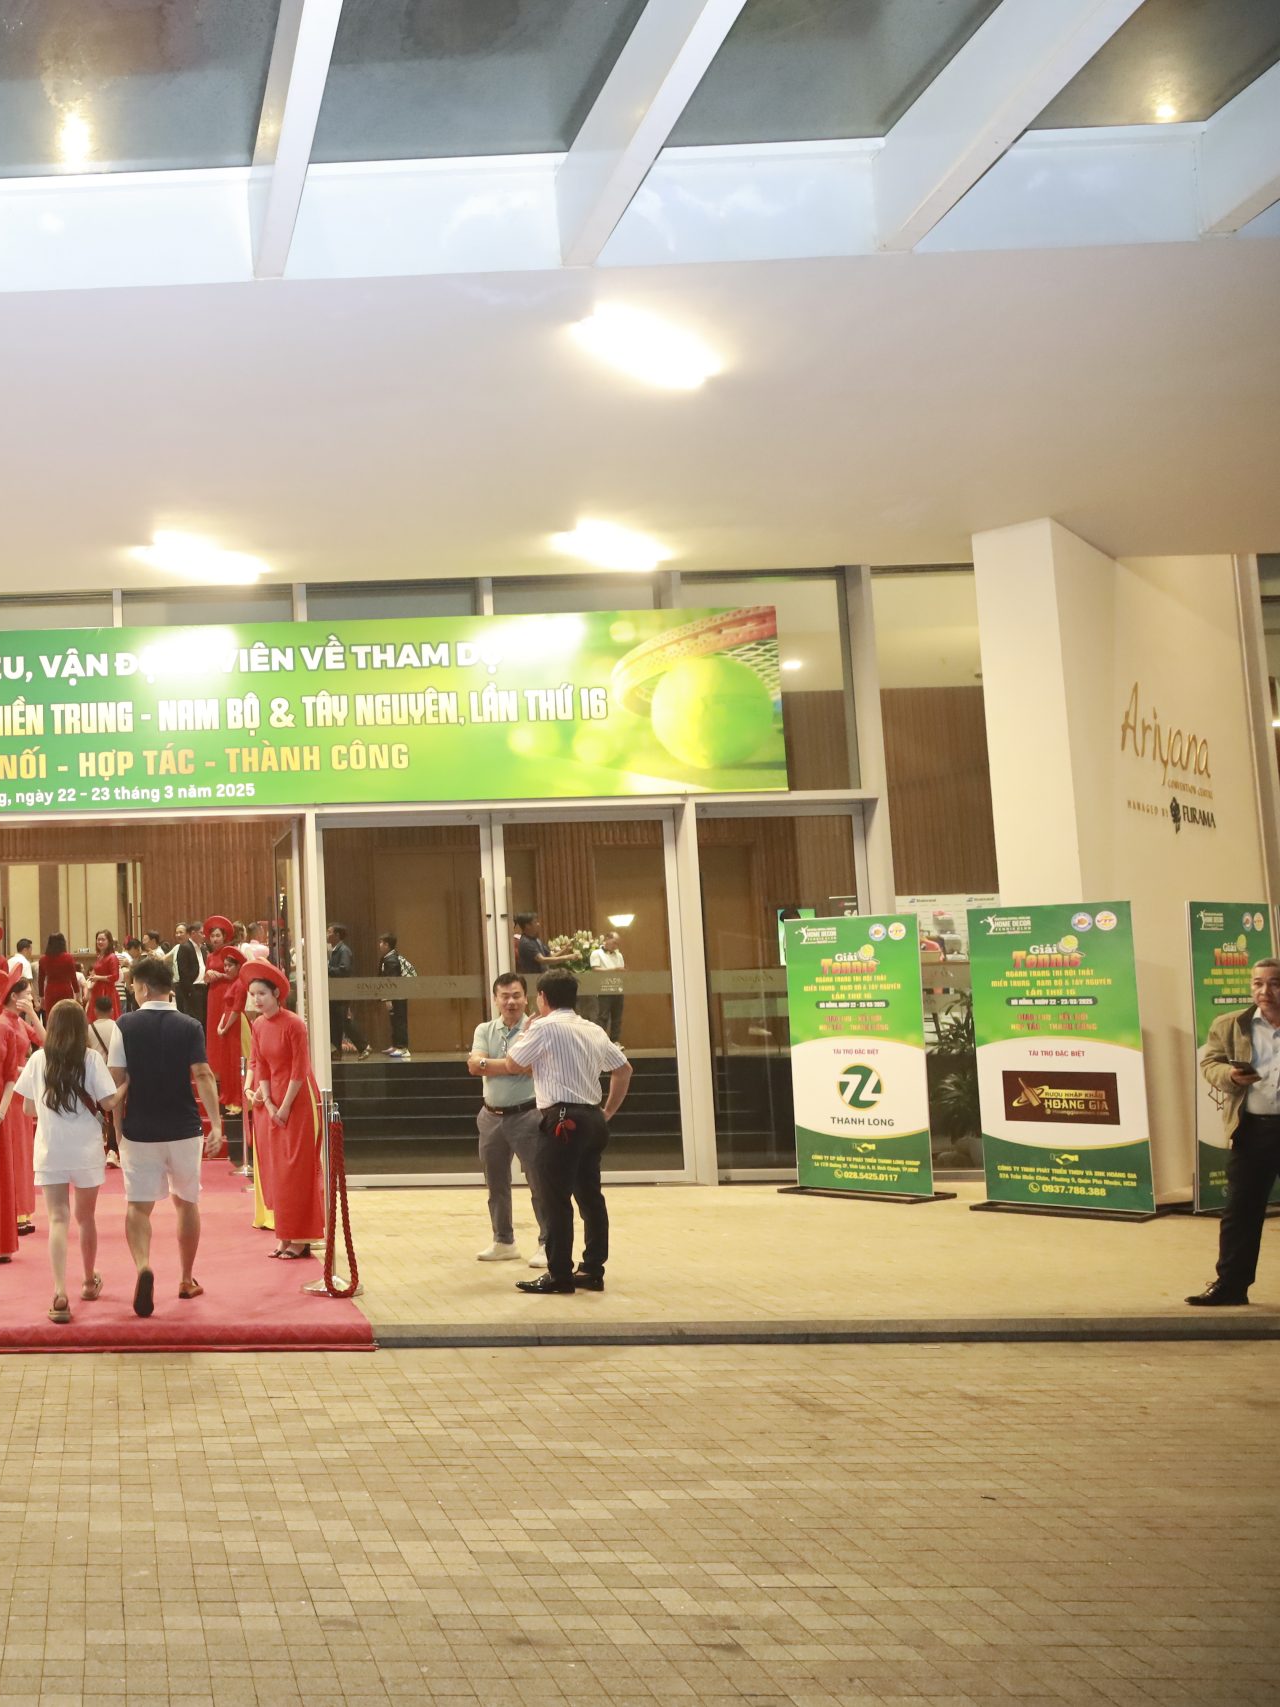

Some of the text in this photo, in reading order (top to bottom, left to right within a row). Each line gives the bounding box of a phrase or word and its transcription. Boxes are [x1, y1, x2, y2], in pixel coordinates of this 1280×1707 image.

[39, 648, 108, 686] VẬN
[222, 641, 294, 673] VIÊN
[301, 635, 346, 671] VỀ
[351, 642, 450, 670] THAM
[51, 701, 133, 735] TRUNG
[158, 698, 220, 732] NAM
[226, 692, 261, 736] BỘ
[270, 697, 296, 728] &
[302, 690, 349, 726] TÂY
[355, 687, 465, 727] NGUYÊN,
[470, 682, 519, 724] LẦN
[524, 683, 575, 721] THỨ
[580, 687, 608, 720] 16
[1121, 682, 1211, 786] Ariyana
[79, 749, 134, 781] HỢP
[143, 743, 195, 776] TÁC
[226, 740, 321, 773] THÀNH
[331, 739, 410, 770] CÔNG
[15, 790, 54, 808] ngày
[57, 789, 76, 802] 22
[91, 788, 110, 801] 23
[114, 786, 160, 804] tháng
[164, 785, 174, 798] 3
[178, 785, 212, 799] năm
[216, 783, 255, 798] 2025
[1182, 805, 1216, 829] FURAMA
[835, 952, 858, 962] Giải
[1012, 950, 1082, 968] Tennis
[1030, 945, 1058, 954] Giải
[1044, 1098, 1109, 1110] HOÀNG GIA
[831, 1116, 895, 1127] THANH LONG
